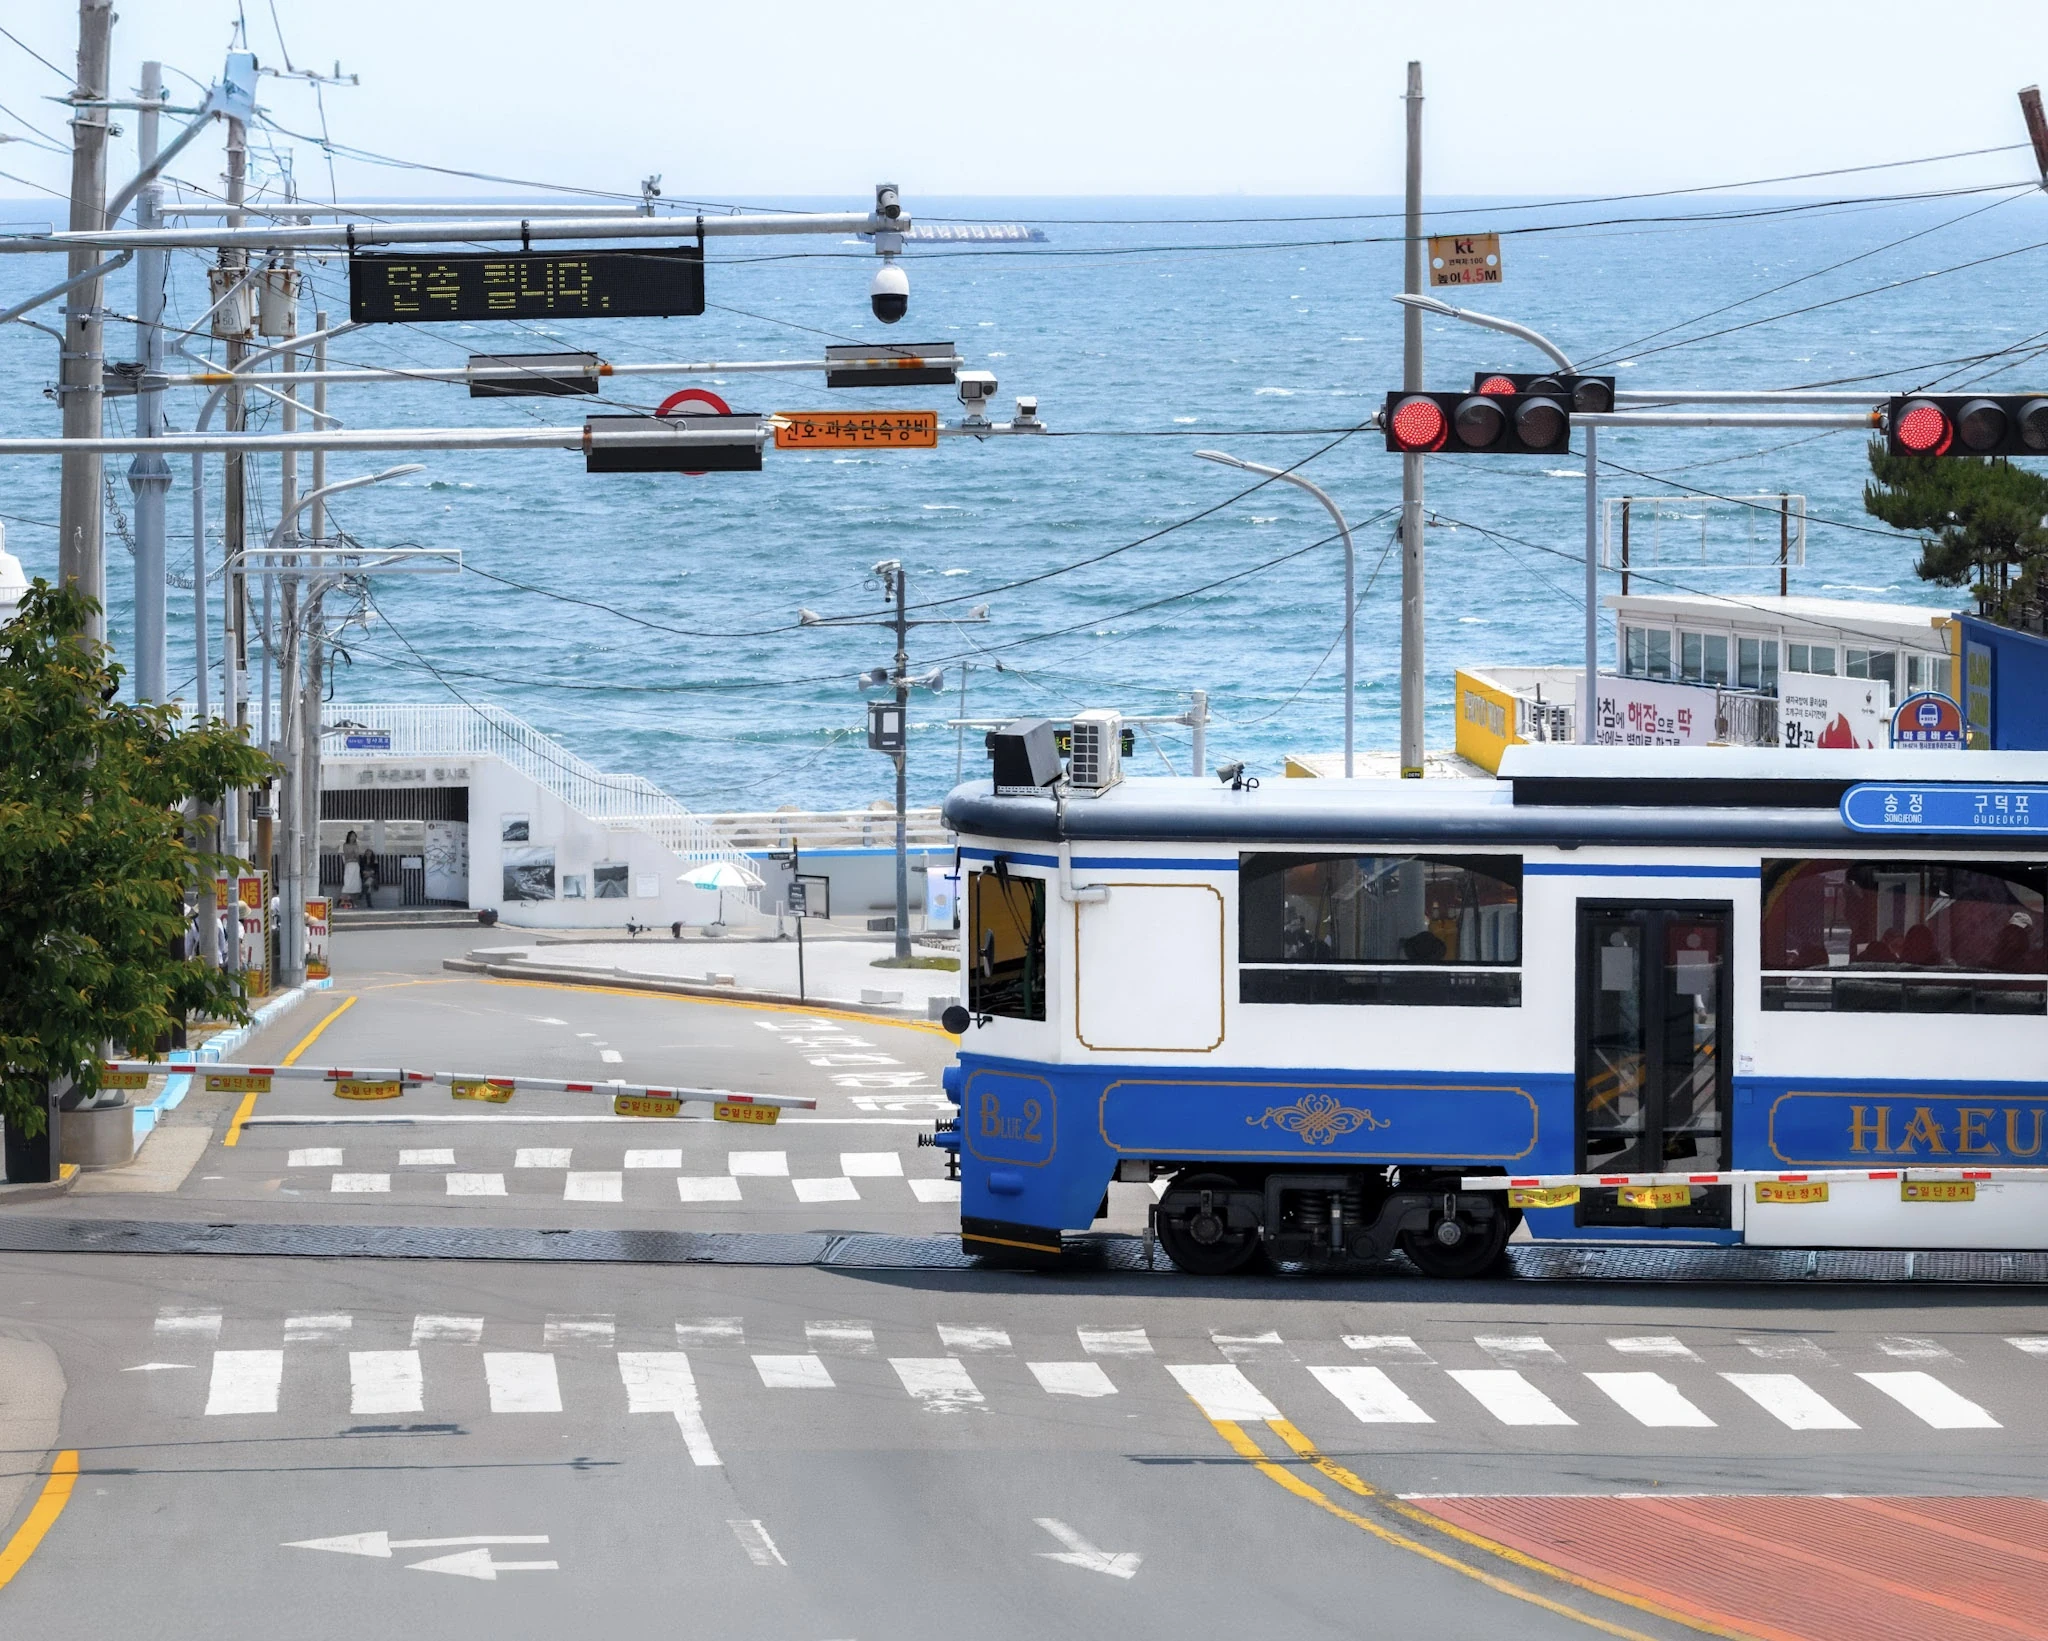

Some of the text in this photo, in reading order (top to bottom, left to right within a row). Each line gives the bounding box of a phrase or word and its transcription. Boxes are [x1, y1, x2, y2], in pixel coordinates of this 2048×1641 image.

[1455, 238, 1474, 254] kt
[388, 265, 460, 310] 단속
[1628, 702, 1674, 734] 해장으로
[1678, 708, 1692, 738] 딱
[1903, 730, 1955, 741] 마을버스
[1884, 794, 2029, 814] 송정 구덕포
[1884, 813, 2029, 825] SONGJEONG GUDEOKPO
[222, 1077, 266, 1089] 일단정지
[351, 1085, 396, 1097] 일단정지
[631, 1100, 676, 1113] 일단정지
[731, 1107, 776, 1120] 일단정지
[1023, 1098, 1042, 1143] 2
[1636, 1191, 1685, 1204] 일단정지
[1773, 1186, 1823, 1199] 일단정지
[1920, 1185, 1970, 1197] 일단정지
